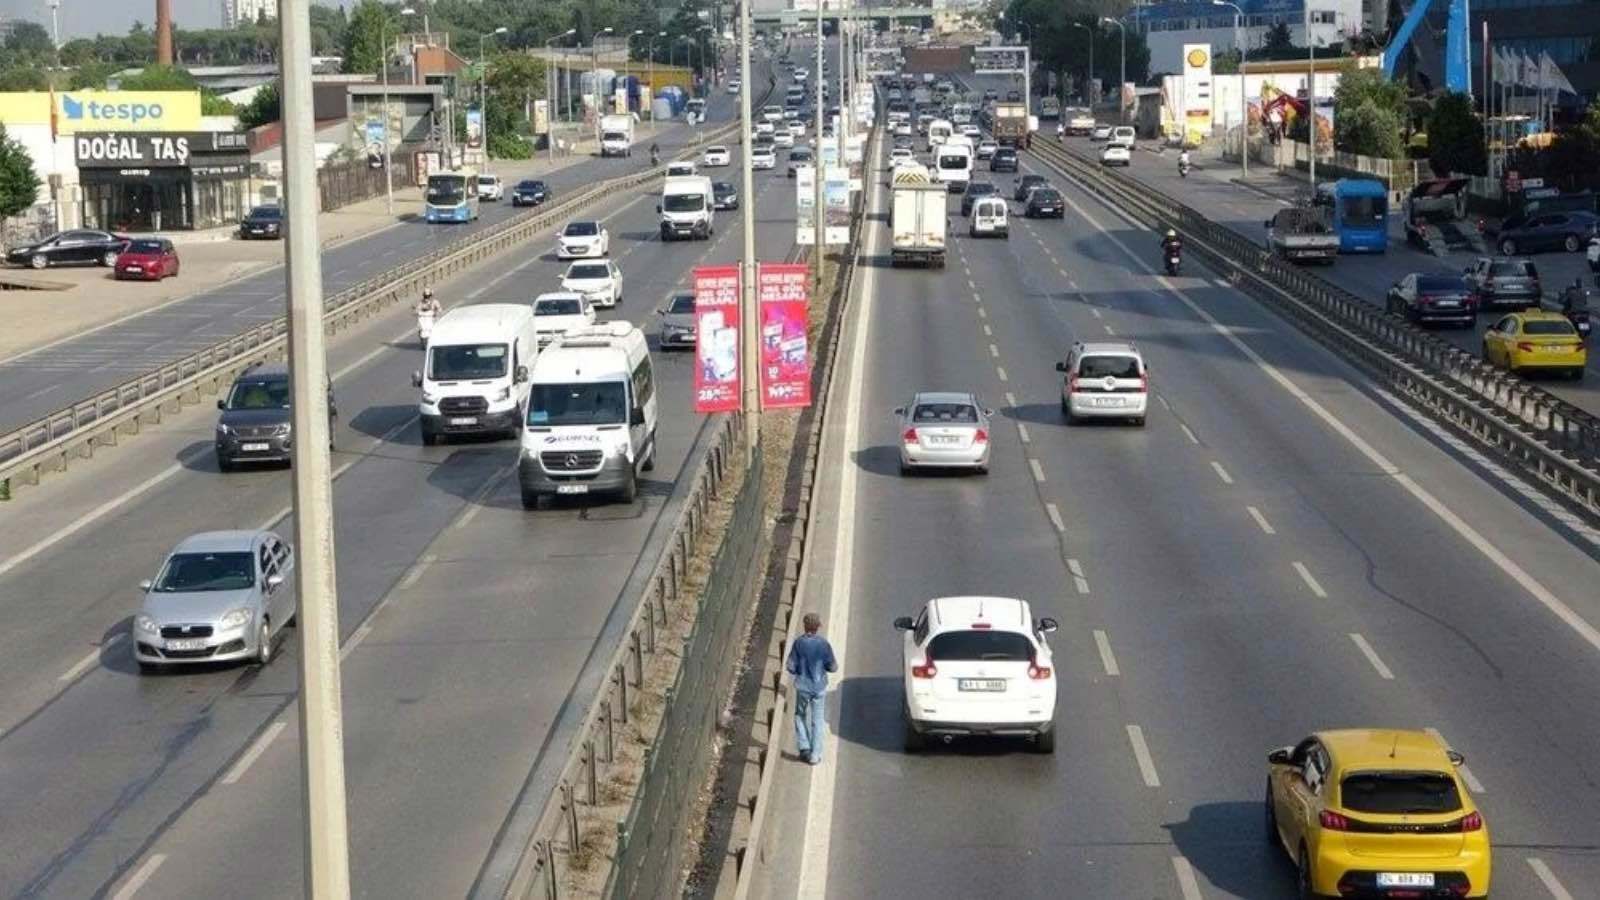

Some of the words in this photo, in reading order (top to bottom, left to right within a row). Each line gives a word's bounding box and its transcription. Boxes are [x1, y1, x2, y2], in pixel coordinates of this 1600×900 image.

[88, 101, 163, 122] tespo
[78, 133, 143, 160] DOĞAL
[151, 137, 189, 165] TAŞ
